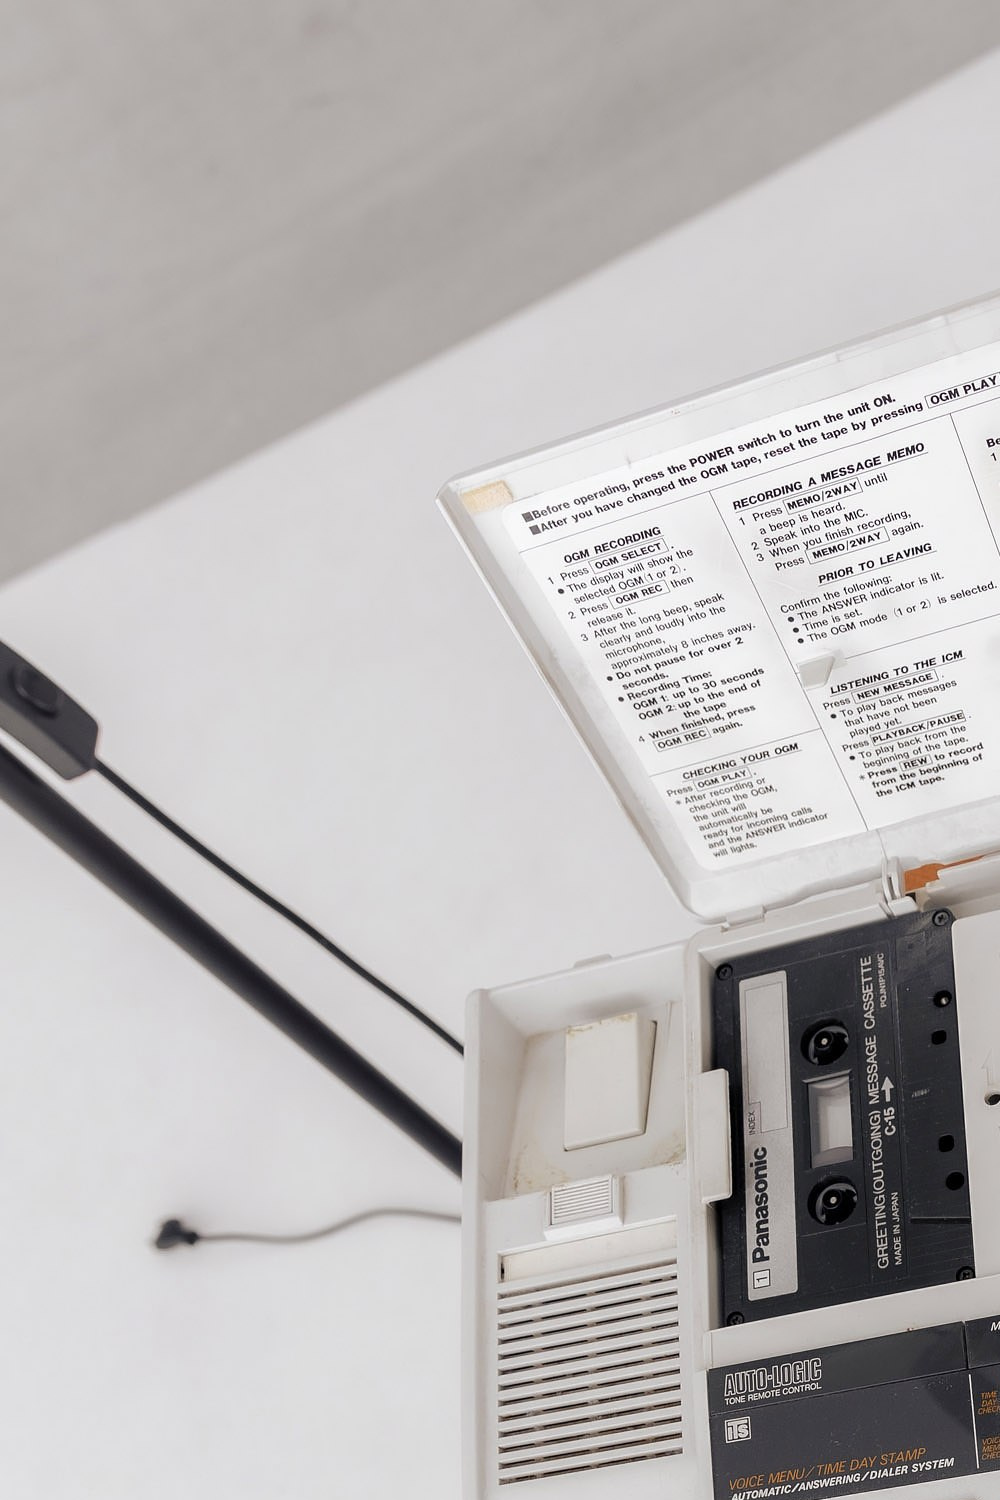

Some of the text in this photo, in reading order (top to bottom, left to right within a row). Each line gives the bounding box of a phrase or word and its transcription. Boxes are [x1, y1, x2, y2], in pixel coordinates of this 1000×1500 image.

[532, 393, 896, 518] Before operating, press the POWER switch to turn the unit ON.
[540, 517, 567, 532] After
[571, 510, 592, 522] you
[594, 500, 623, 513] have
[626, 480, 675, 503] changed
[678, 476, 697, 486] the
[700, 463, 728, 479] OGM
[730, 456, 761, 469] tape,
[763, 442, 795, 459] reset
[797, 437, 817, 447] the
[820, 427, 848, 440] tape
[851, 420, 866, 431] by
[870, 402, 923, 426] pressing
[930, 388, 959, 404] OGM
[962, 376, 997, 394] PLAY
[732, 442, 924, 510] RECORDING A MESSAGE MEMO
[563, 526, 661, 563] OGM RECORDING
[818, 542, 932, 583] PRIOR TO LEAVING
[830, 650, 962, 694] LISTENING TO THE ICM
[682, 742, 798, 779] CHECKING YOUR OGM
[860, 955, 875, 1029] CASSETTE
[866, 1035, 881, 1104] MESSAGE
[748, 1110, 756, 1136] INDEX
[883, 1106, 895, 1136] C-15
[750, 1146, 770, 1263] Panasonic
[890, 1191, 902, 1265] MADE IN JAPAN
[756, 1274, 768, 1284] 1
[724, 1382, 822, 1405] TONE REMOTE CONTROL
[729, 1475, 763, 1491] VOICE
[850, 1456, 877, 1470] DAY
[880, 1448, 926, 1466] STAMP
[911, 1458, 954, 1473] SYSTEM
